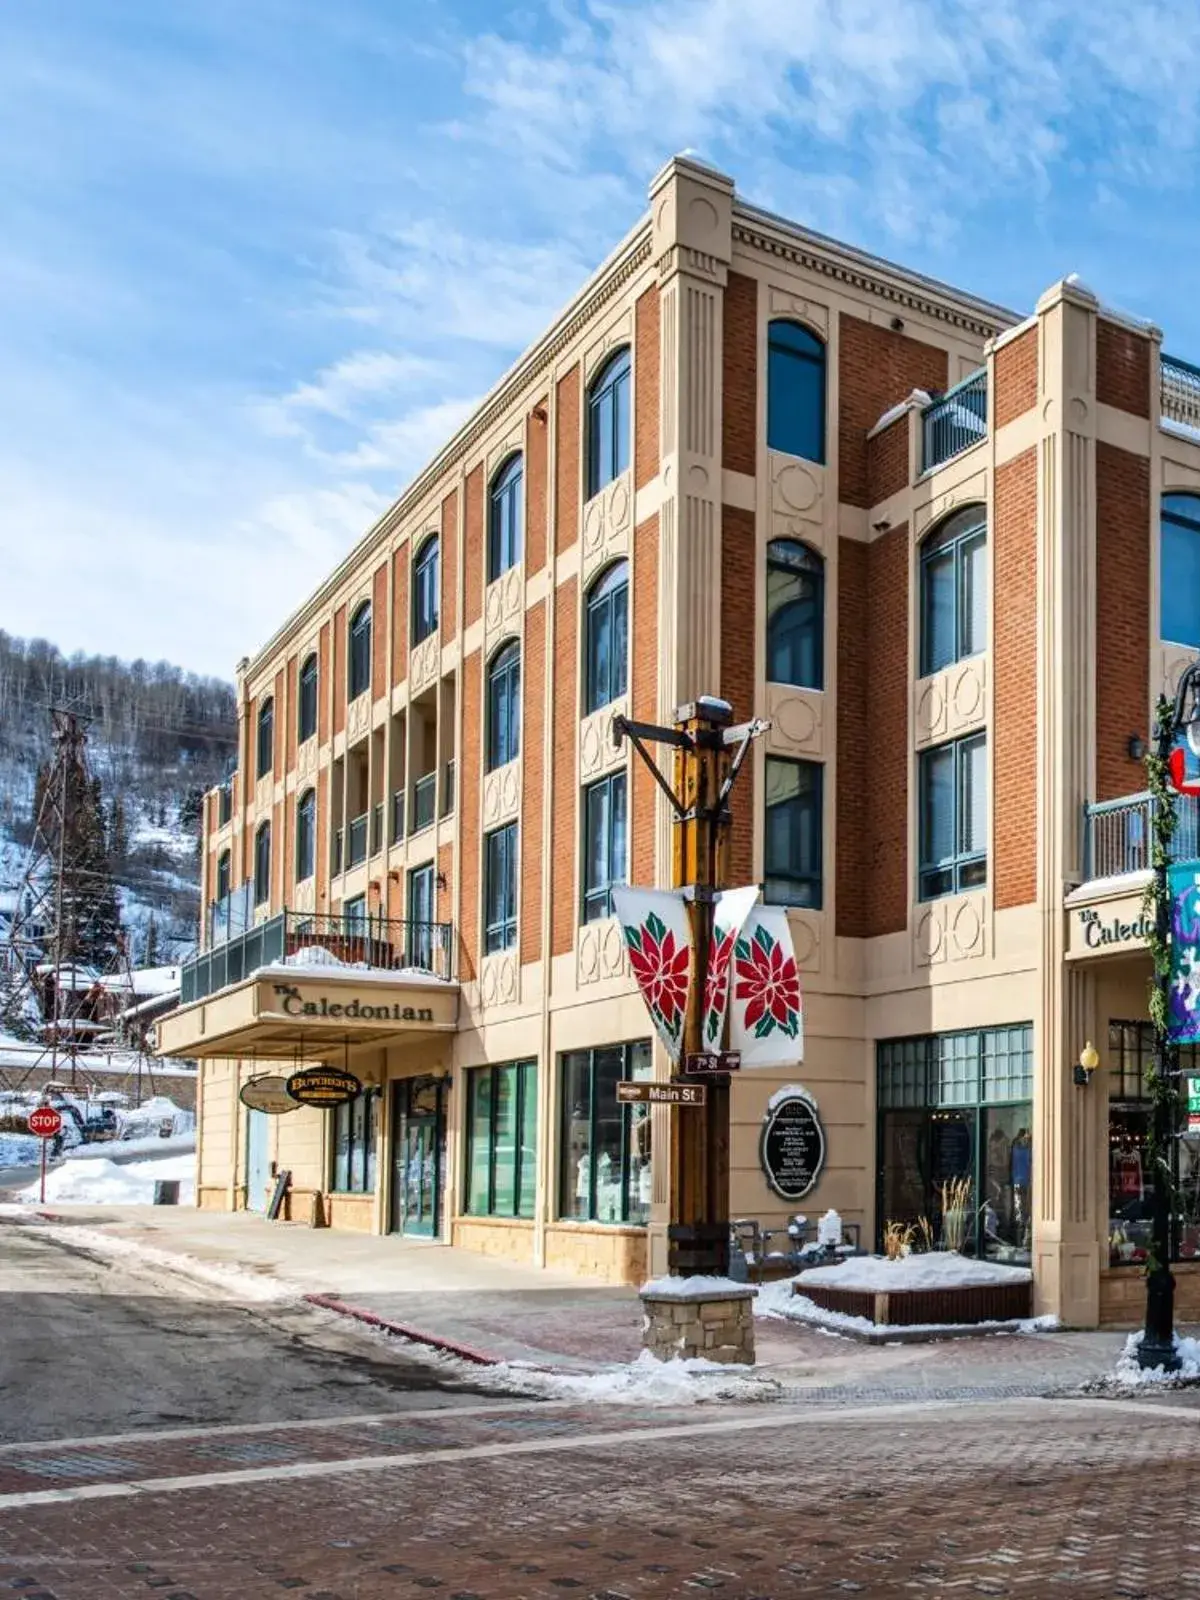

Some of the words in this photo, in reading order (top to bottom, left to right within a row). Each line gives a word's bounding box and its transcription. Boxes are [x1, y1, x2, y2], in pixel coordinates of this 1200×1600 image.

[1078, 909, 1098, 922] The
[283, 994, 433, 1021] Caledonian
[708, 1057, 718, 1069] St
[649, 1087, 679, 1100] Main
[682, 1088, 696, 1101] St
[31, 1116, 60, 1127] STOP
